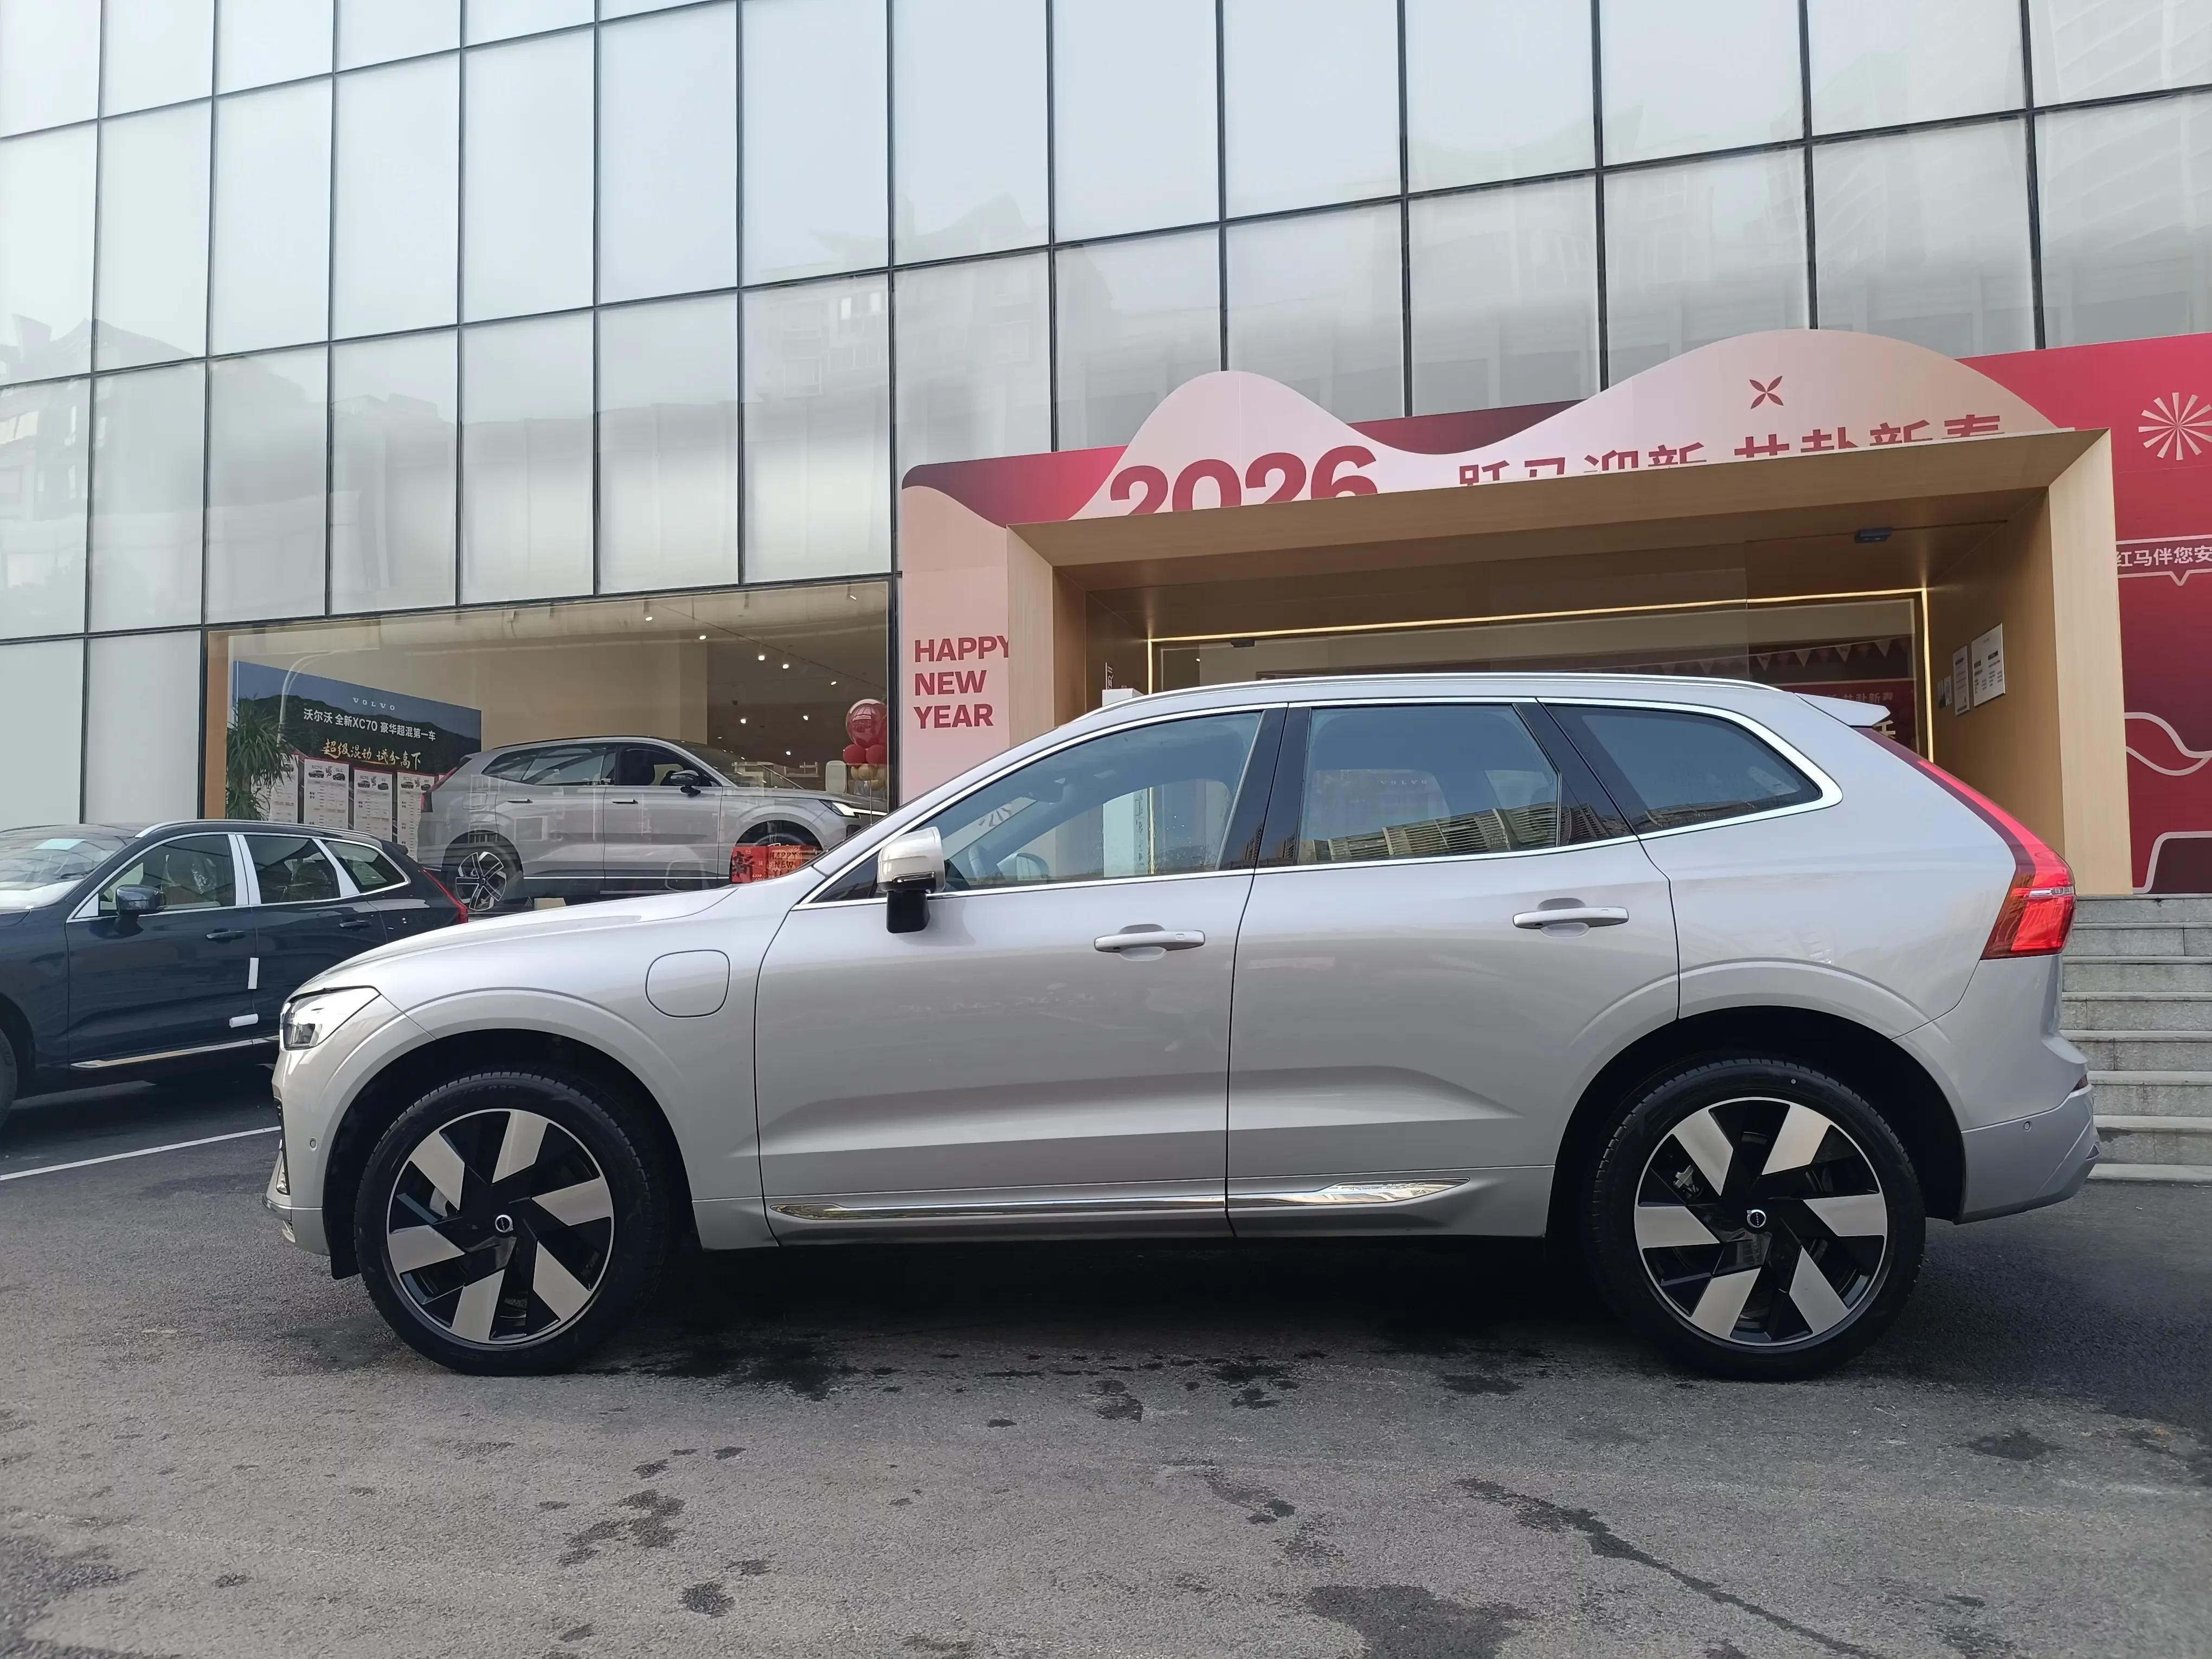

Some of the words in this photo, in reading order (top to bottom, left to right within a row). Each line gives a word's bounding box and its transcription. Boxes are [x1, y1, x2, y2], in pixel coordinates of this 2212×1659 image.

[1110, 445, 1378, 516] 2026
[2116, 545, 2212, 567] 红马伴您安
[915, 635, 1009, 663] HAPPY
[915, 670, 987, 696] NEW
[352, 697, 395, 710] VOLVO
[303, 708, 333, 724] 沃尔沃
[335, 713, 378, 731] 全新XC70
[380, 722, 436, 742] 豪华超混第一车
[913, 703, 994, 729] YEAR
[321, 738, 372, 761] 超级混动
[769, 852, 798, 860] HAPPY
[775, 860, 794, 869] NEW
